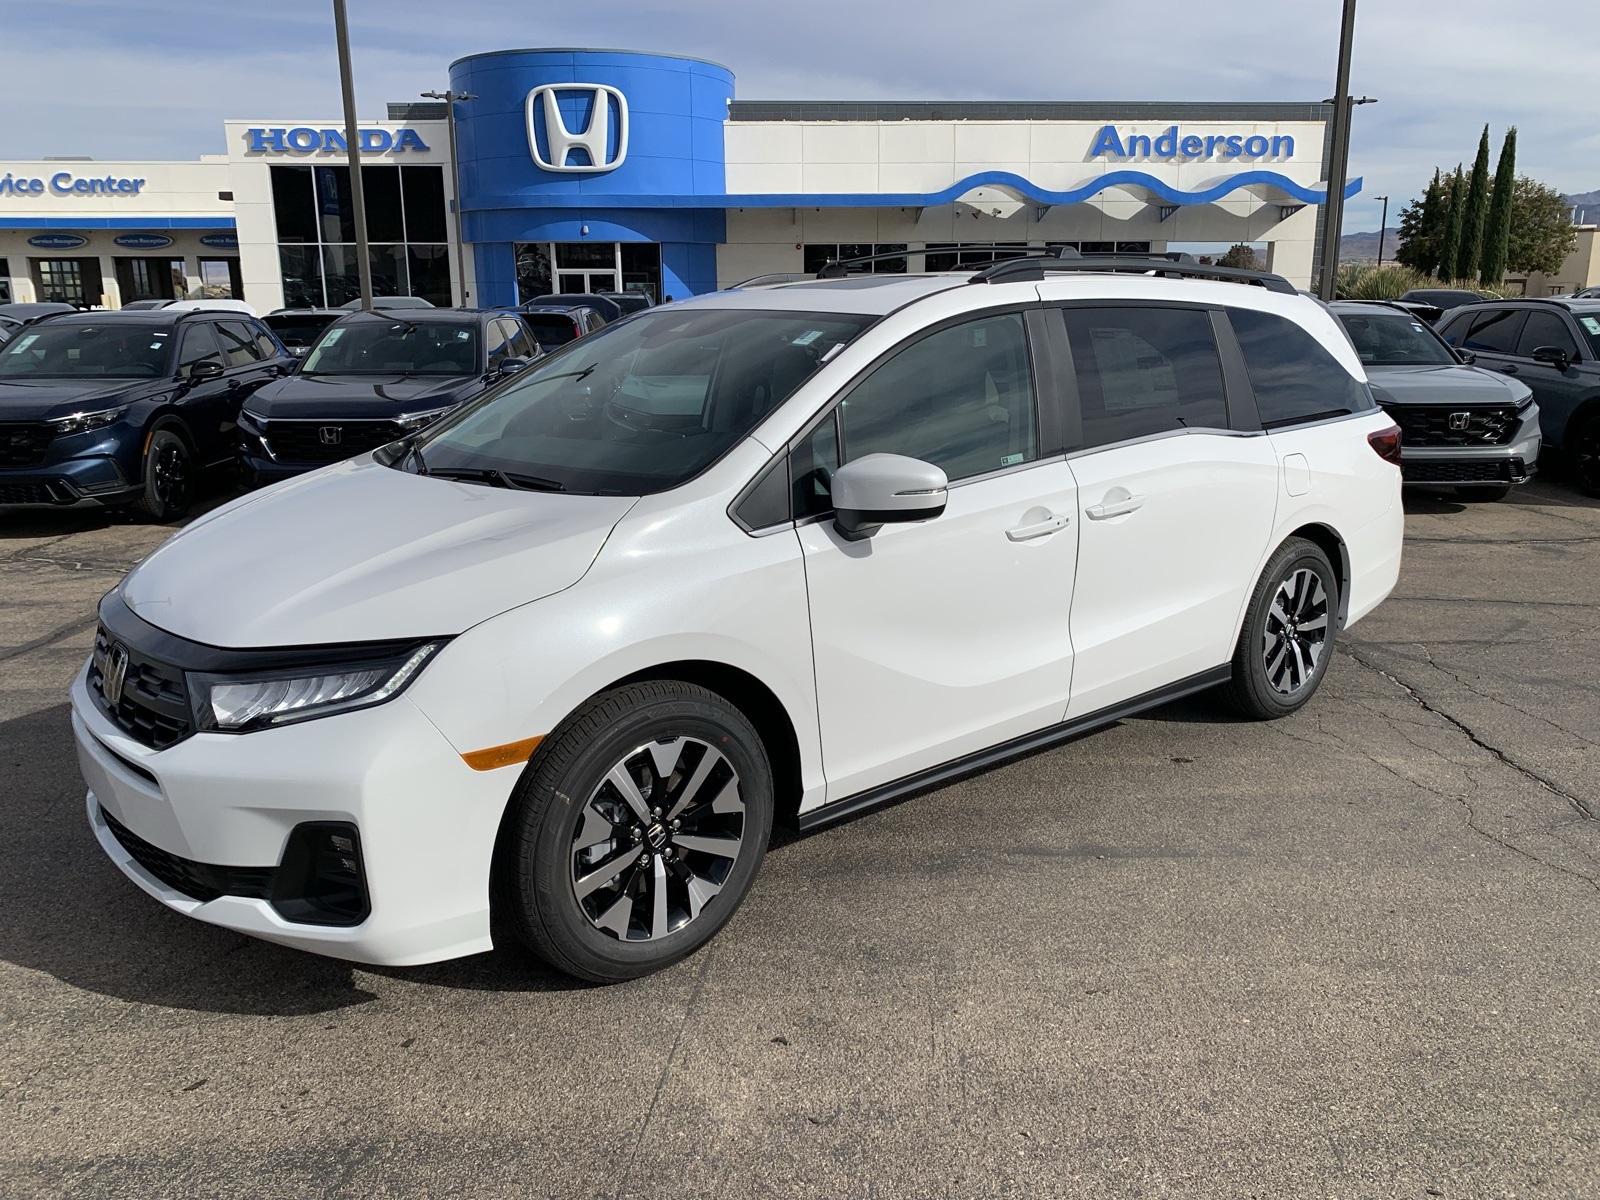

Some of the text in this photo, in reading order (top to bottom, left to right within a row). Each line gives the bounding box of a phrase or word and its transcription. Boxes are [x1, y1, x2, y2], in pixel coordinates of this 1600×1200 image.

[248, 128, 430, 152] HONDA
[1092, 126, 1295, 158] Anderson
[51, 172, 145, 193] Center
